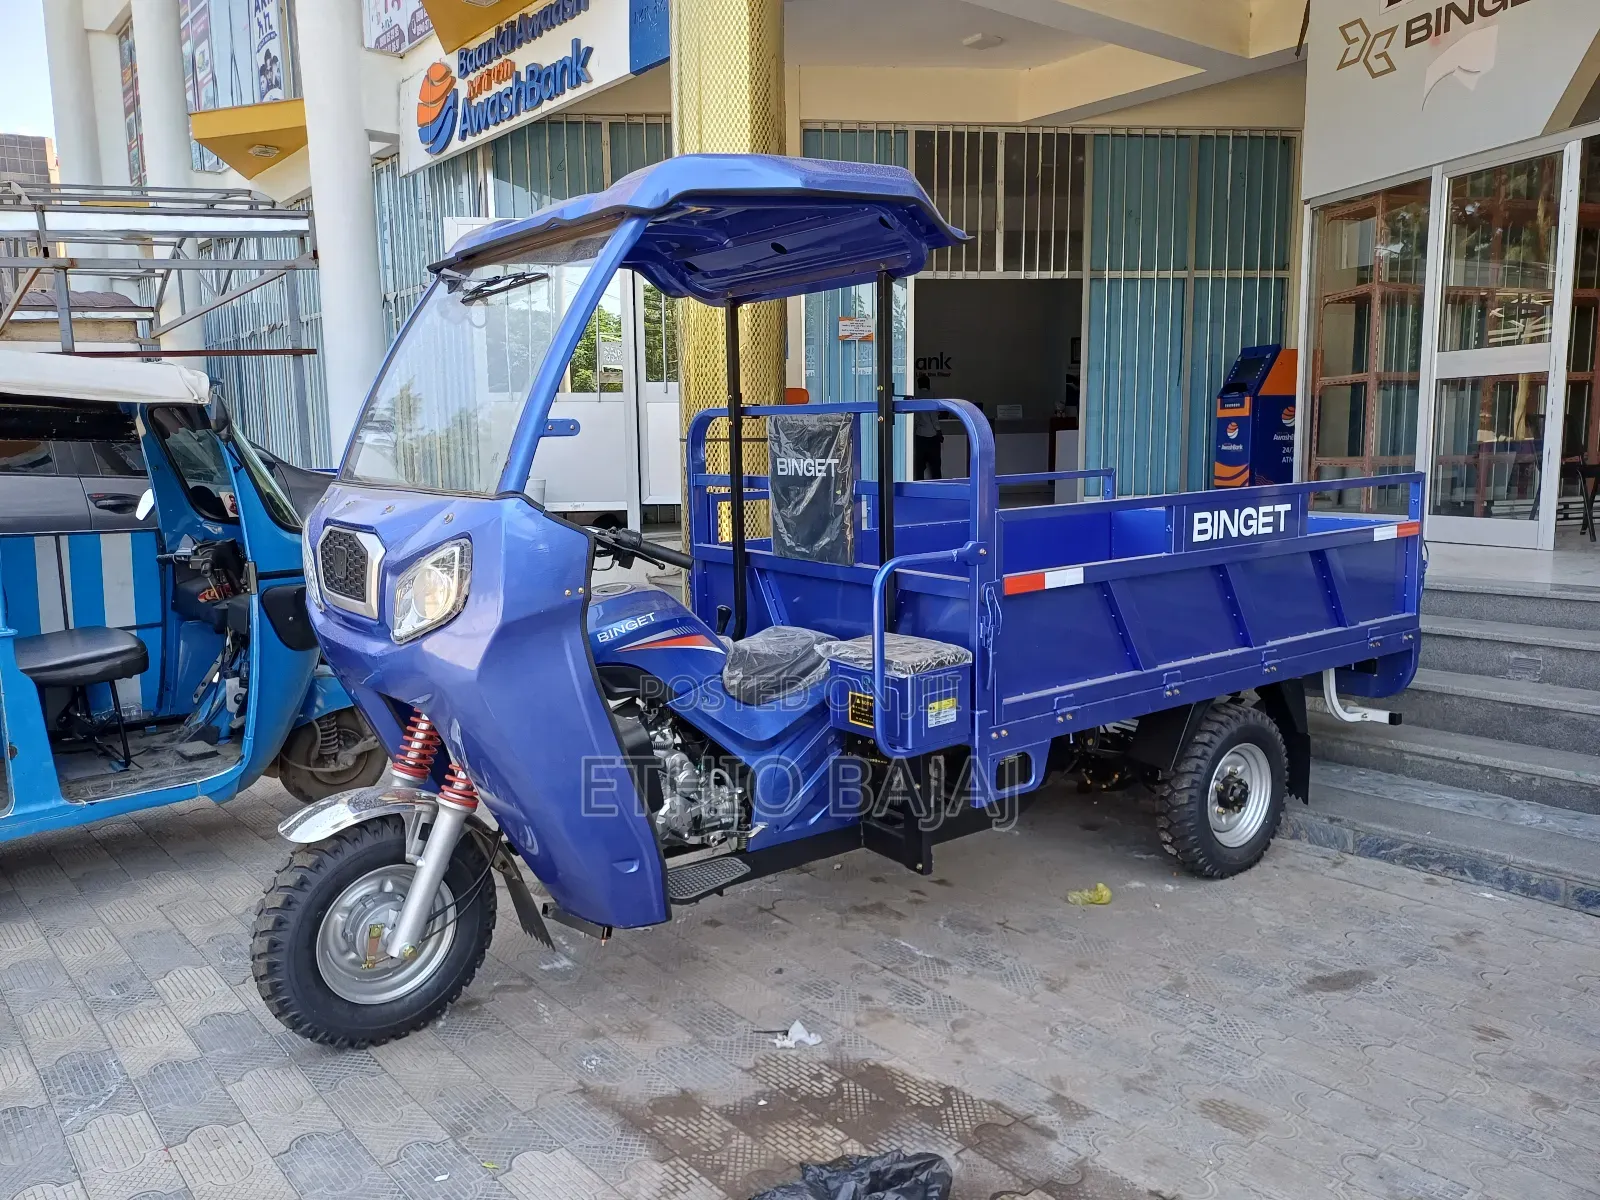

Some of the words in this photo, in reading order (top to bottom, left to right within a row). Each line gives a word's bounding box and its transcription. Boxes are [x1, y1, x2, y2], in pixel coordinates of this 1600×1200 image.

[1404, 0, 1531, 49] BING
[776, 457, 839, 478] BINGET
[1192, 503, 1292, 543] BINGET
[596, 611, 656, 643] BINGET
